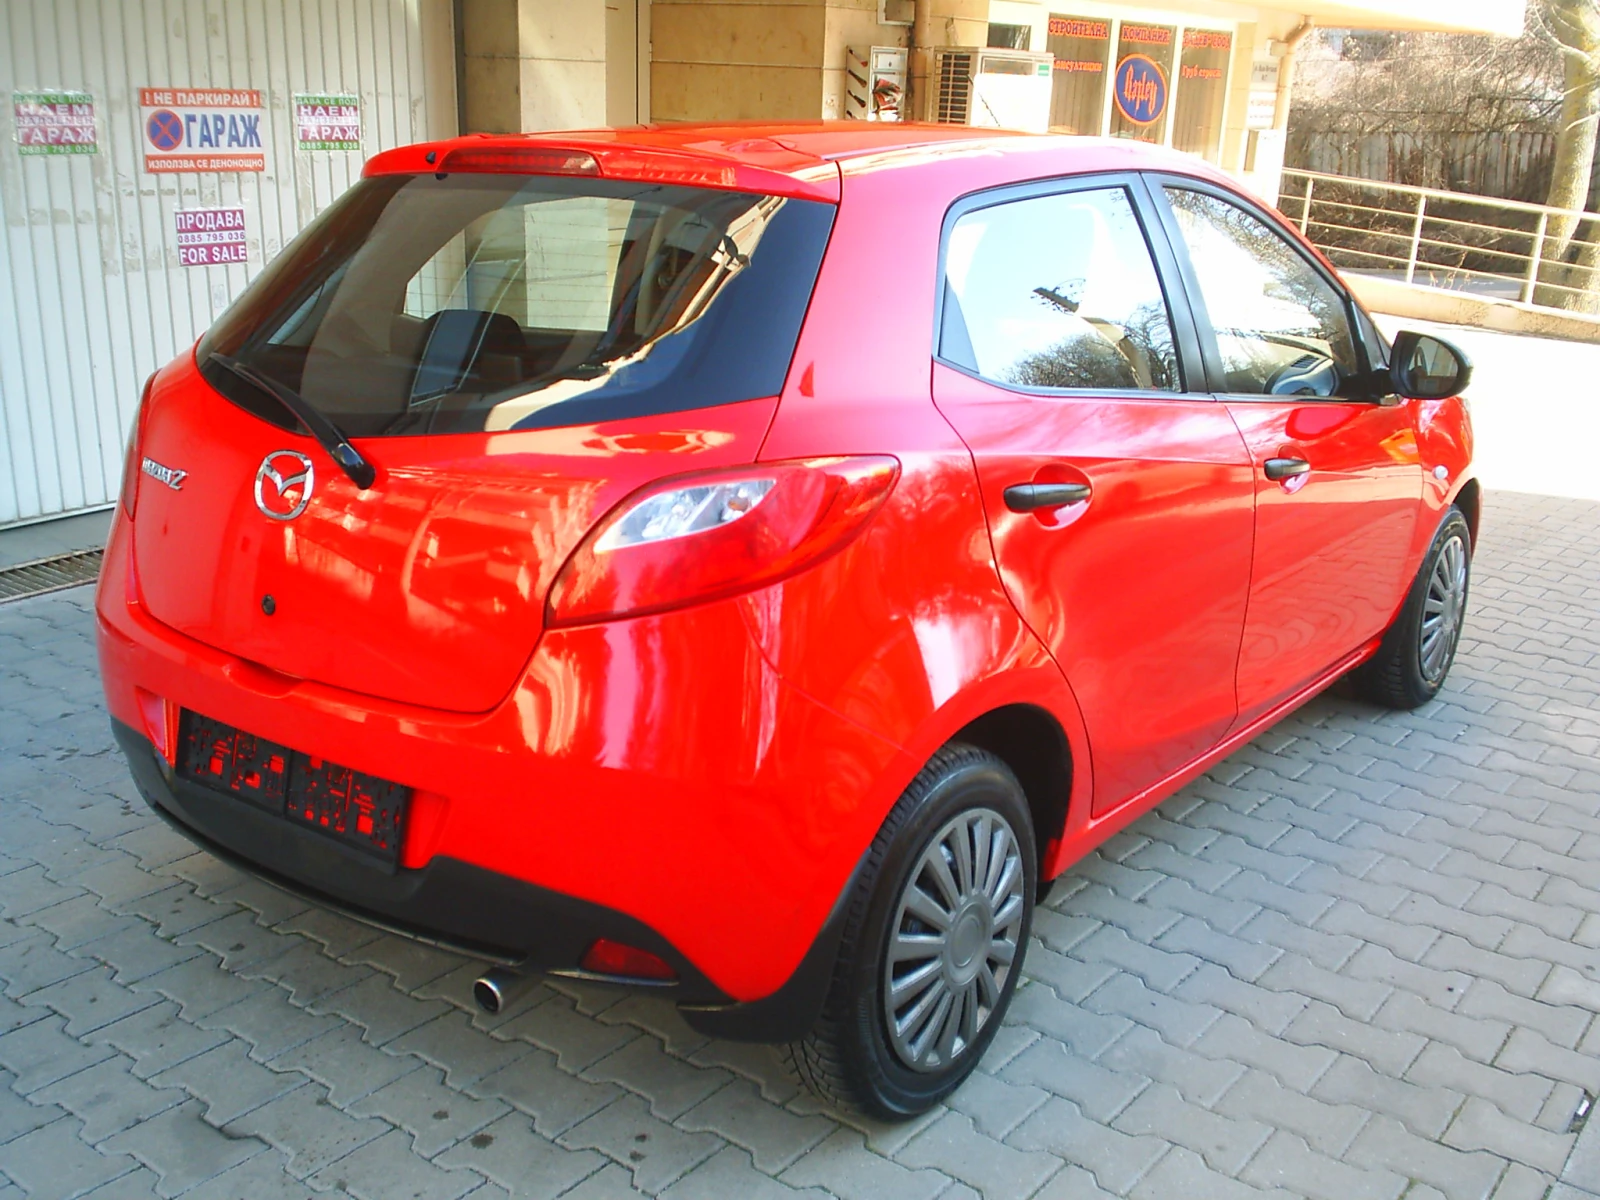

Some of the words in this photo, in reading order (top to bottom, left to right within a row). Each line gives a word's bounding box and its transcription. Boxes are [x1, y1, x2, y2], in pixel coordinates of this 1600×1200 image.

[1048, 18, 1108, 39] СТРОИТЕЛНА
[153, 92, 173, 105] НЕ
[176, 91, 249, 106] ПАРКИРАЙ
[324, 97, 336, 105] СЕ
[19, 104, 90, 115] НАЕМ
[300, 105, 355, 116] НАЕМ
[18, 127, 95, 143] ГАРАЖ
[184, 113, 262, 148] ГАРАЖ
[298, 126, 358, 140] ГАРАЖ
[148, 159, 195, 169] ИЗПОЛЗВА
[196, 159, 208, 168] СЕ
[210, 158, 263, 169] ДЕНОНОЩНО
[176, 211, 244, 231] ПРОДАВА
[177, 234, 202, 243] 0885
[206, 233, 224, 241] 795
[228, 231, 246, 240] 036
[179, 247, 208, 264] FOR
[212, 245, 247, 262] SALE
